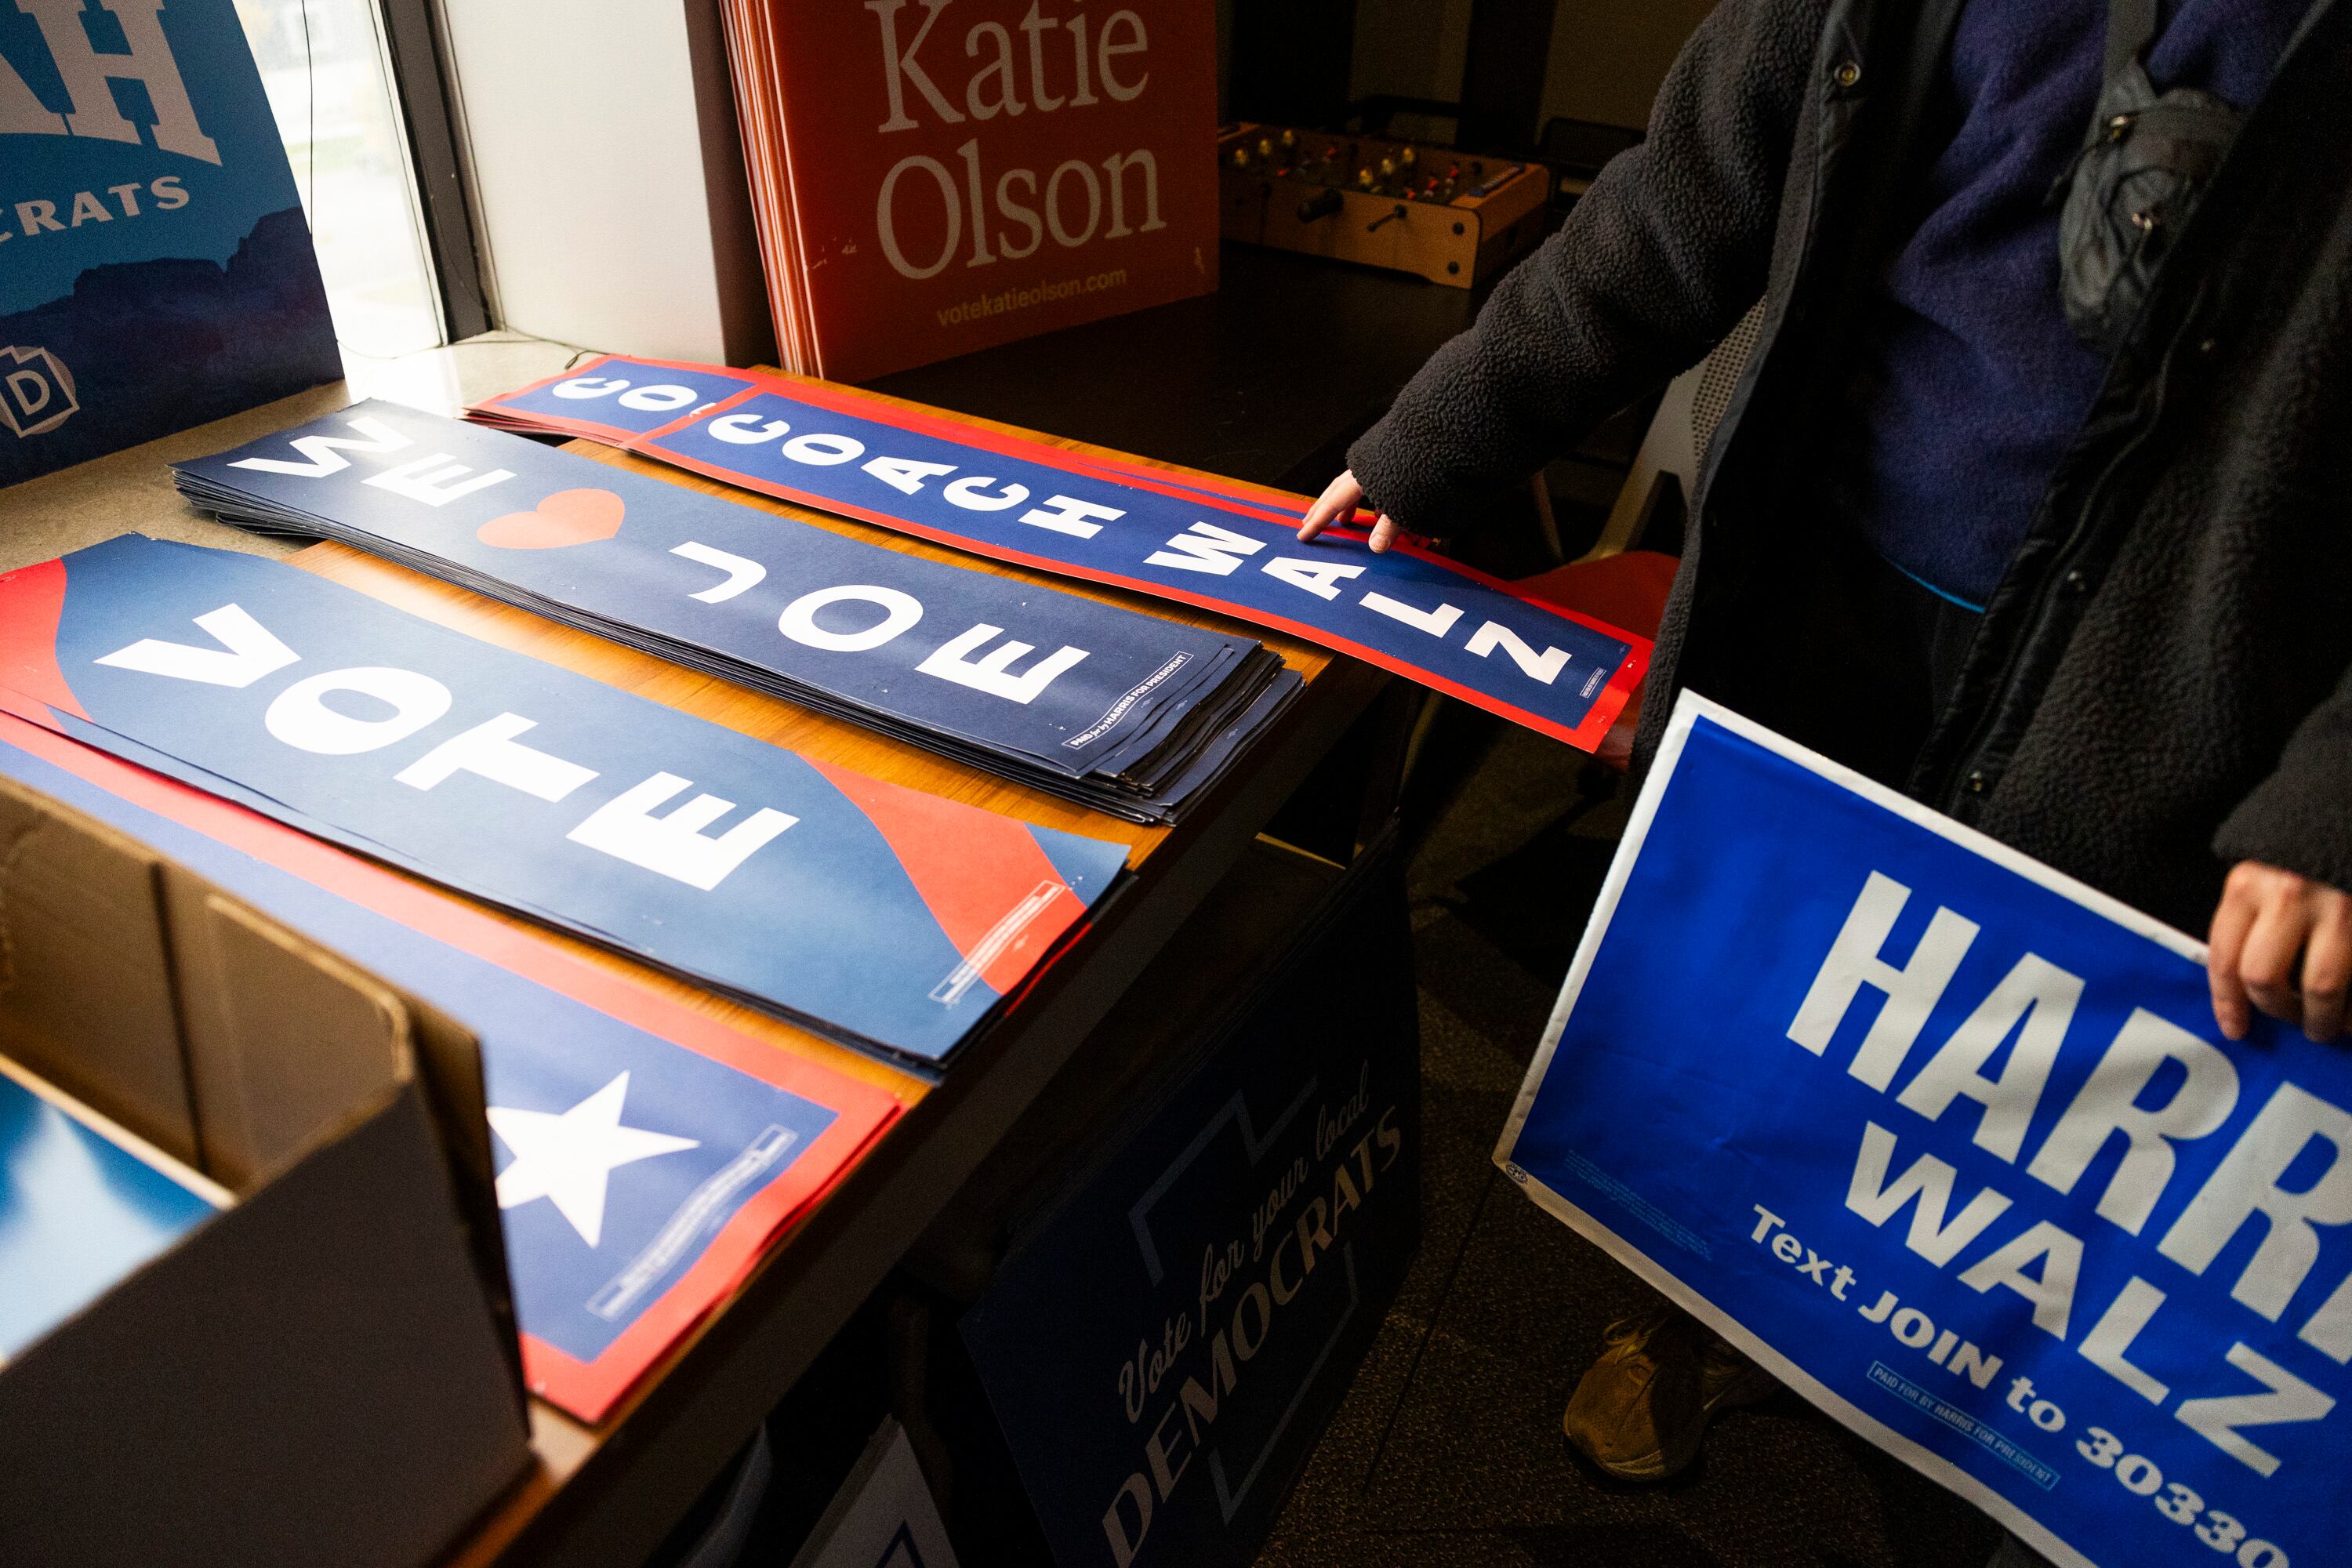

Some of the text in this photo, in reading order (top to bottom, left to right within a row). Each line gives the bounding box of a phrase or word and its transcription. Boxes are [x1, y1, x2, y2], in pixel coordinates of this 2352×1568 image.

[864, 0, 1149, 133] Katie
[0, 176, 190, 243] RATS
[877, 137, 1167, 280] Olson
[938, 268, 1127, 326] votekatieolson.com
[552, 377, 717, 416] CO
[227, 416, 1091, 705] WE JOE
[708, 414, 1573, 685] COACH WALZ
[93, 603, 800, 891] VOTE
[1069, 734, 1094, 746] PAID
[1103, 695, 1135, 725] HARRIS
[1130, 684, 1151, 697] FOR
[1145, 655, 1187, 687] PRESIDENT
[1102, 1103, 1403, 1568] DEMOCRATS
[1118, 1058, 1370, 1424] Vote for your local
[1845, 1120, 2336, 1479] WALZ
[1751, 1203, 1857, 1302] Text
[1859, 1290, 2003, 1389] JOIN
[2006, 1377, 2067, 1432] to
[2076, 1426, 2290, 1568] 30330
[1874, 1367, 1899, 1388] PAID
[1898, 1382, 1918, 1401] FOR
[1918, 1395, 1936, 1409] BY
[1934, 1403, 1976, 1433] HARRIS
